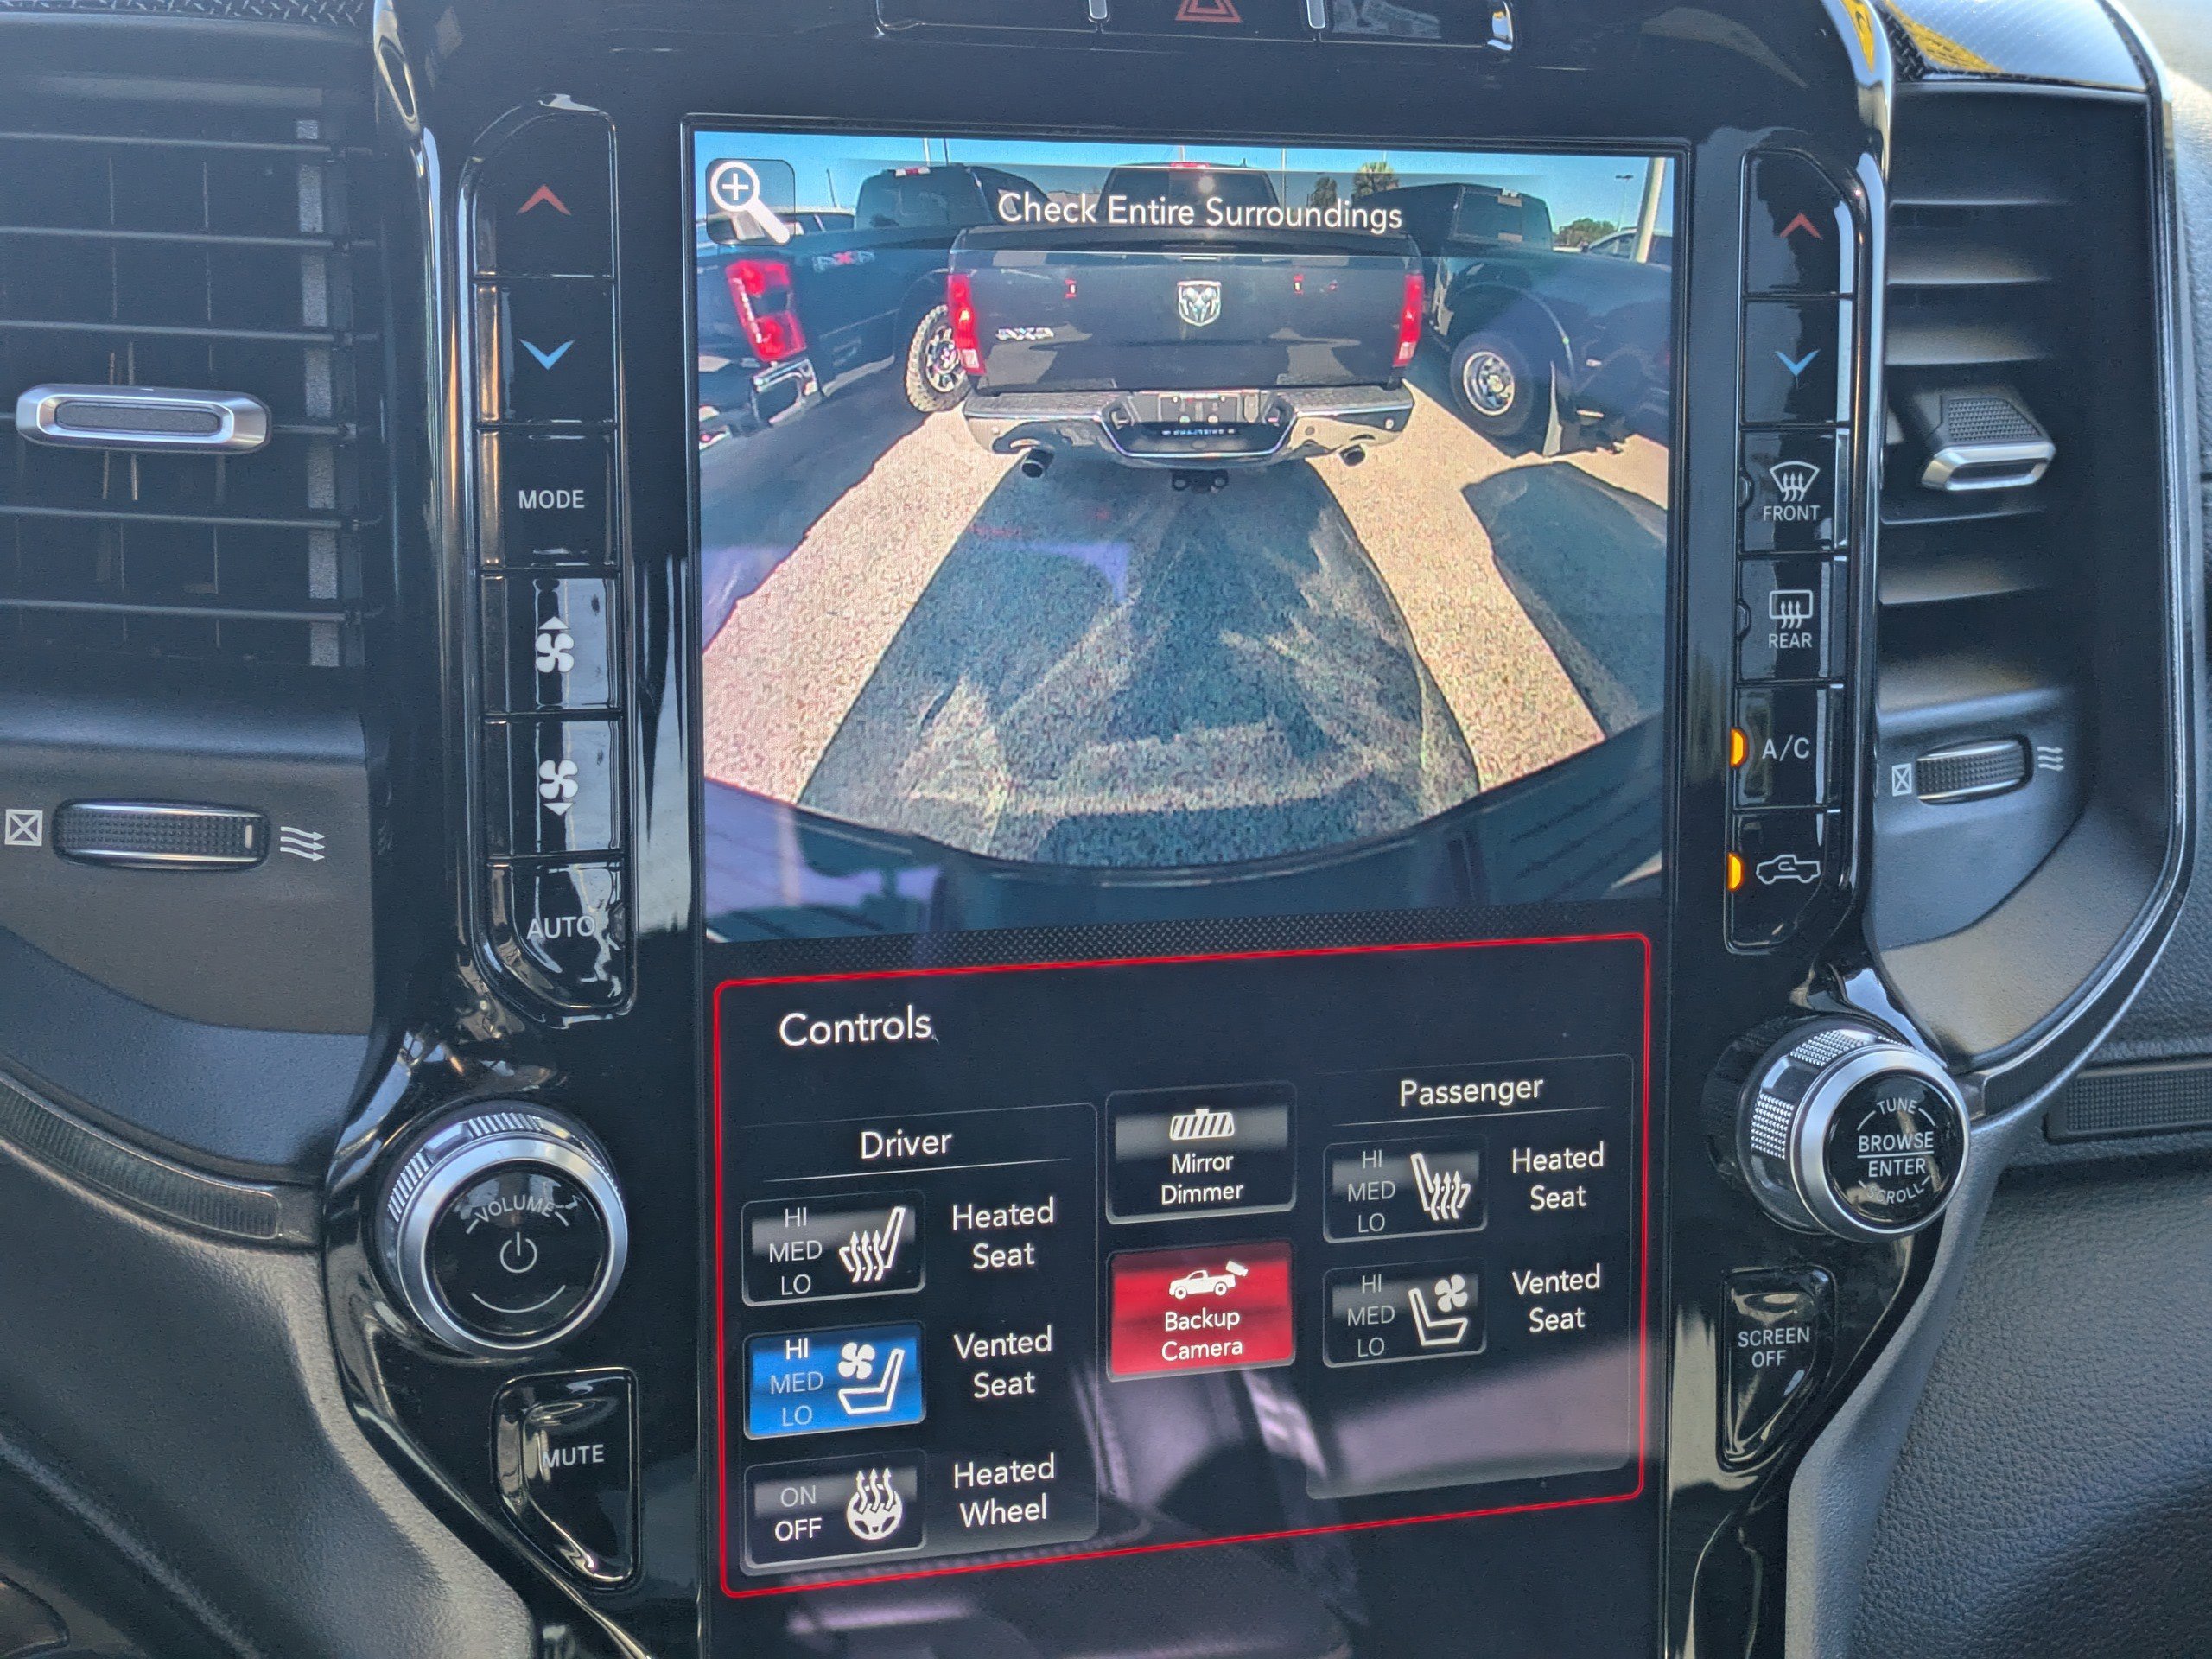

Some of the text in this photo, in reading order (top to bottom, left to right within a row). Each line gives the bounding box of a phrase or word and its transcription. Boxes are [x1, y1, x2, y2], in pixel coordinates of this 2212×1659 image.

[997, 191, 1403, 235] Check Entire Surroundings
[518, 490, 585, 510] MODE
[1763, 505, 1821, 522] FRONT
[1768, 633, 1813, 649] REAR
[1761, 735, 1810, 760] A/C
[526, 916, 596, 939] AUTO
[779, 1004, 933, 1046] Controls
[1400, 1078, 1544, 1107] Passenger
[1876, 1097, 1919, 1116] TUNE
[861, 1129, 952, 1160] Driver
[1858, 1131, 1935, 1153] BROWSE
[1171, 1153, 1235, 1174] Mirror
[1362, 1149, 1382, 1169] HI
[1512, 1141, 1605, 1173] Heated
[1867, 1158, 1926, 1178] ENTER
[1161, 1183, 1244, 1205] Dimmer
[1348, 1180, 1395, 1202] MED
[1529, 1185, 1587, 1211] Seat
[1866, 1183, 1924, 1205] SCROLL
[474, 1194, 556, 1223] VOLUME
[784, 1207, 808, 1228] HI
[951, 1196, 1055, 1230] Heated
[1357, 1213, 1386, 1233] LO
[768, 1240, 823, 1263] MED
[972, 1242, 1035, 1270] Seat
[781, 1274, 811, 1296] LO
[1362, 1274, 1382, 1294] HI
[1512, 1262, 1601, 1296] Vented
[1165, 1306, 1241, 1332] Backup
[1347, 1305, 1395, 1327] MED
[1529, 1306, 1586, 1332] Seat
[785, 1338, 809, 1360] HI
[953, 1325, 1053, 1359] Vented
[1357, 1337, 1385, 1357] LO
[1738, 1327, 1810, 1348] SCREEN
[1161, 1339, 1243, 1362] Camera
[1751, 1350, 1787, 1369] OFF
[771, 1370, 823, 1395] MED
[973, 1371, 1036, 1399] Seat
[782, 1405, 812, 1427] LO
[542, 1444, 605, 1468] MUTE
[953, 1452, 1056, 1489] Heated
[780, 1484, 817, 1507] ON
[960, 1493, 1047, 1529] Wheel
[774, 1517, 822, 1541] OFF
